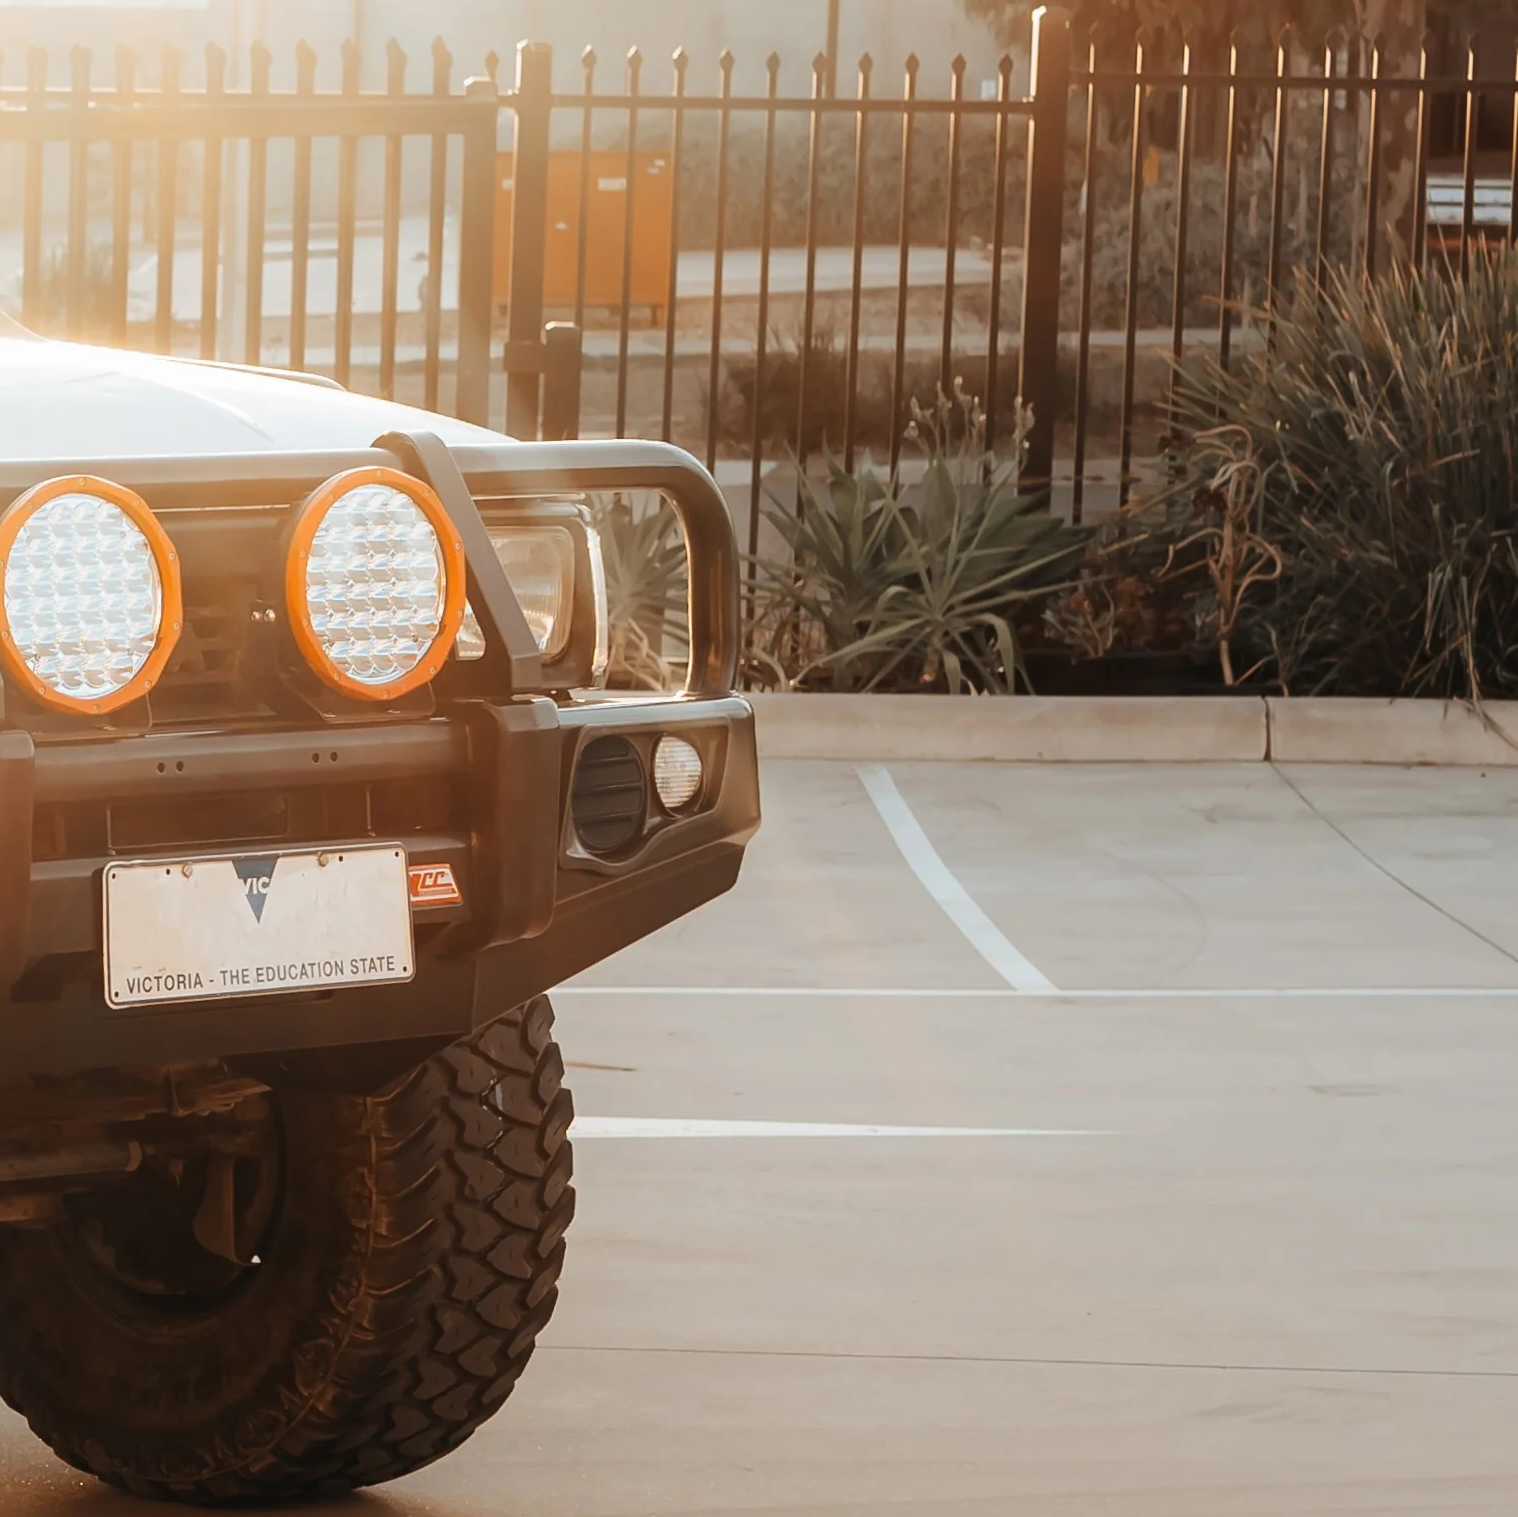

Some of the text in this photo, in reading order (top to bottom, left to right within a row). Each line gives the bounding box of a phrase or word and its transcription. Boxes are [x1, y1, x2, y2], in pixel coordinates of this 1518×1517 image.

[126, 972, 204, 994] VICTORIA
[220, 968, 250, 986] THE
[255, 960, 345, 983] EDUCATION
[350, 955, 395, 975] STATE
